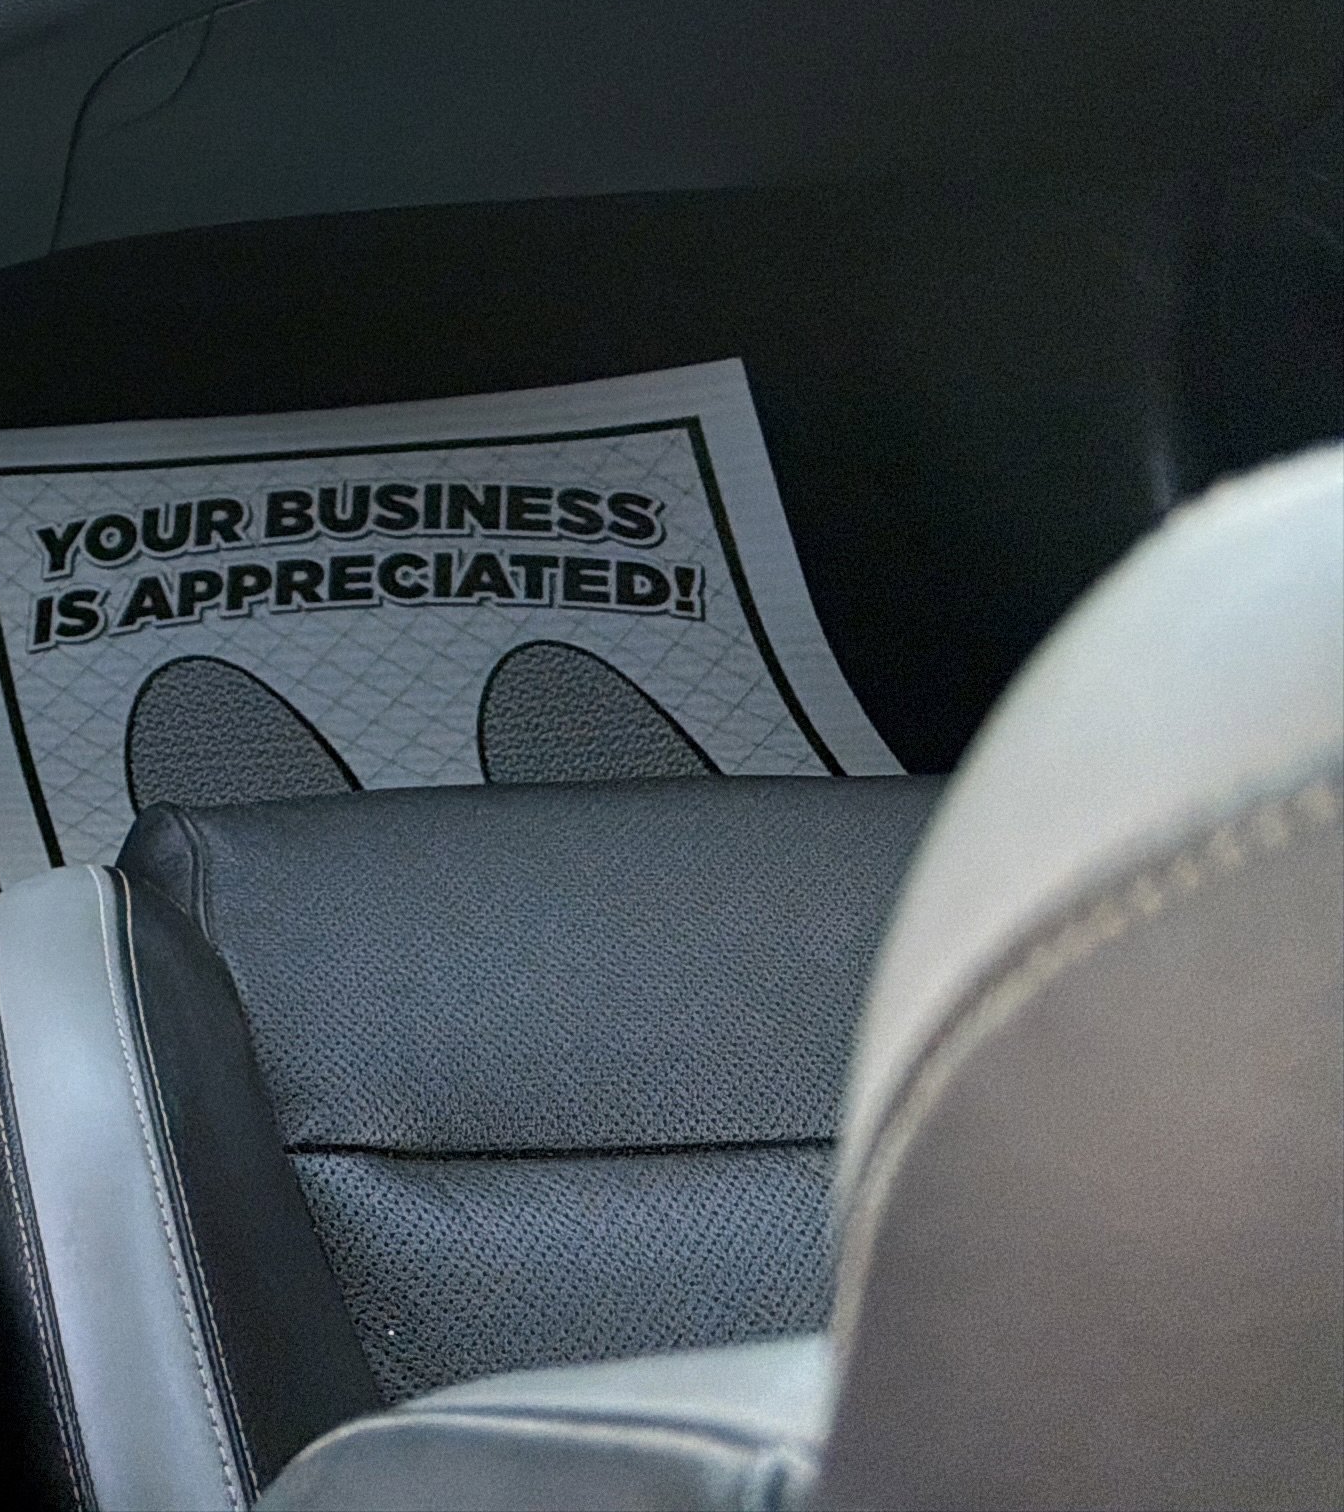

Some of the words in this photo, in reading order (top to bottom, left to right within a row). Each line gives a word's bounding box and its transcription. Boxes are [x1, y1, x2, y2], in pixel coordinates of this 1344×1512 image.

[34, 497, 245, 574] YOUR
[264, 483, 662, 542] BUSINESS
[32, 588, 106, 646] IS
[116, 553, 700, 626] APPRECIATED!
